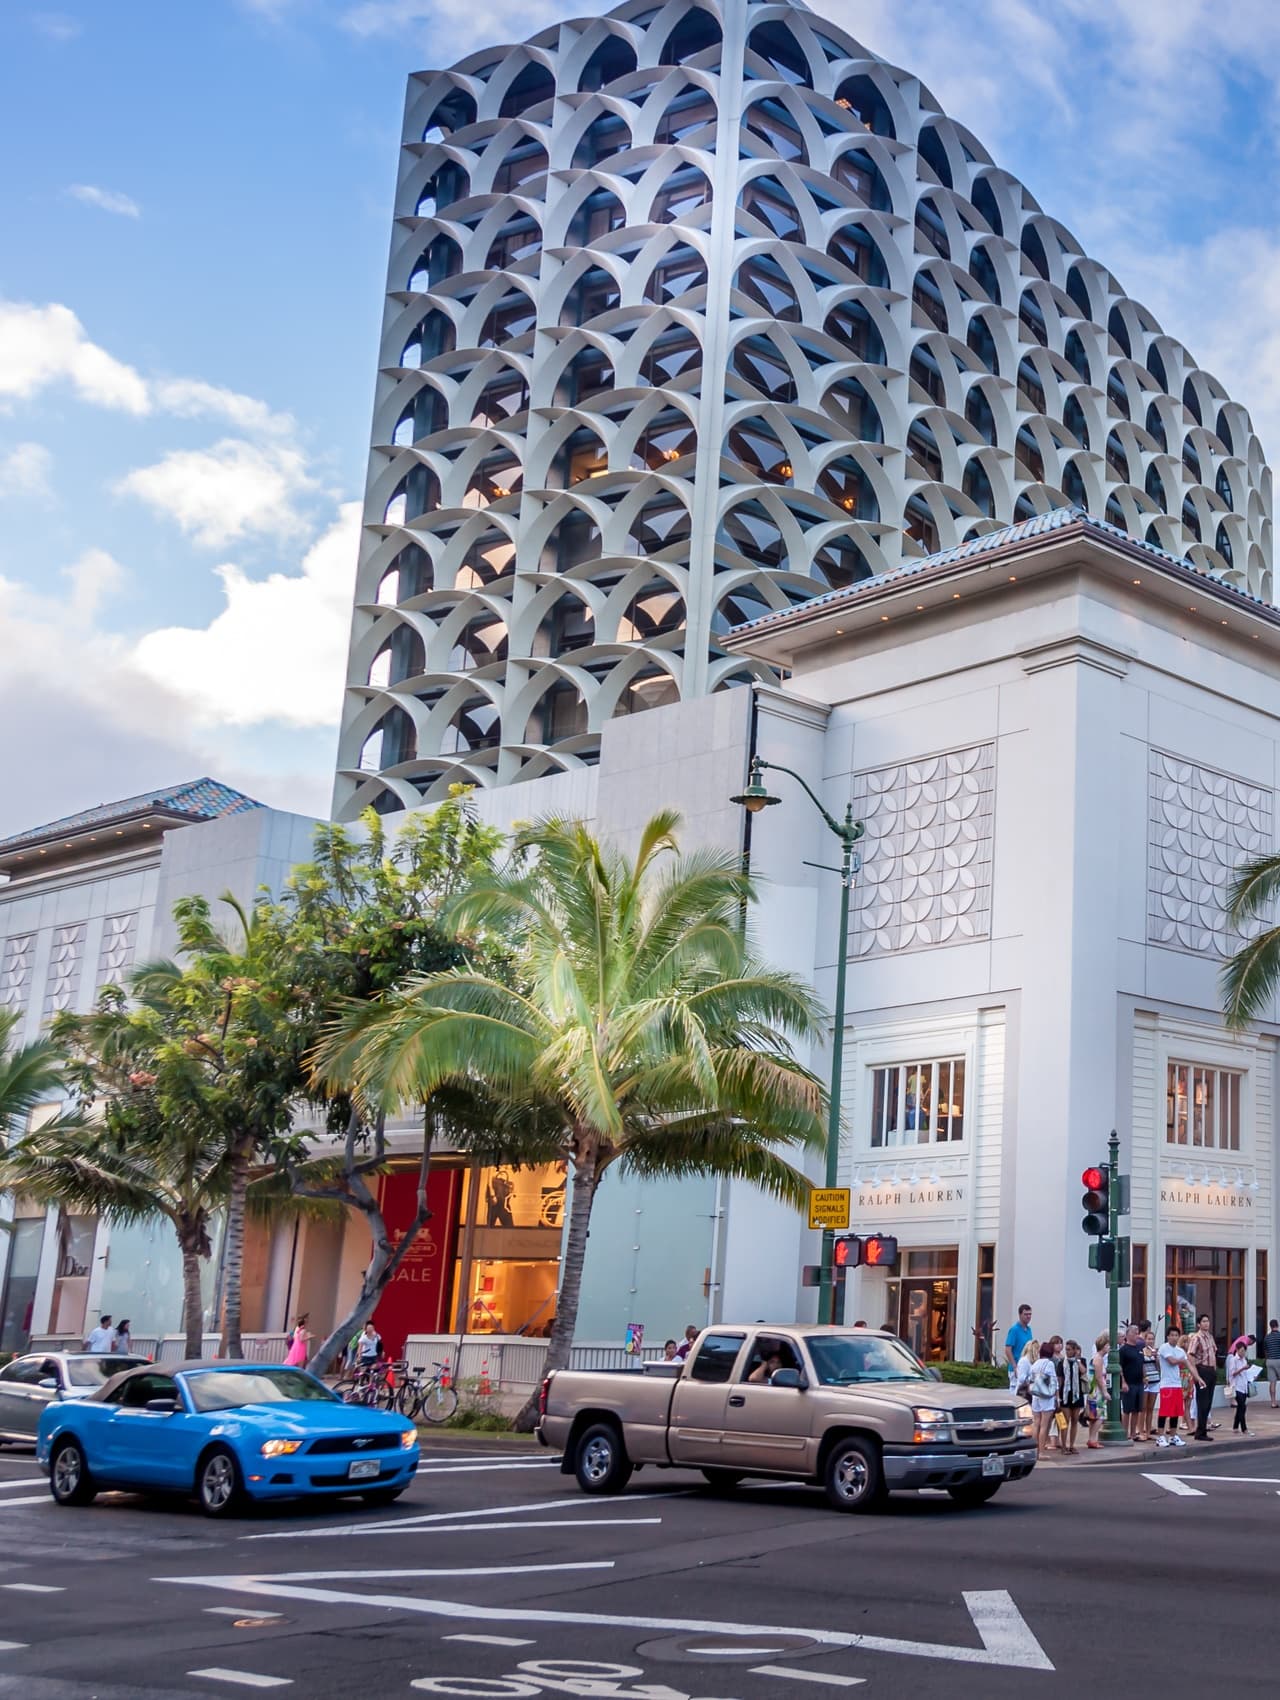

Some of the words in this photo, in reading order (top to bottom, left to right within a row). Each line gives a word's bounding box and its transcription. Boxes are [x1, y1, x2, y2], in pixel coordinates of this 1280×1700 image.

[815, 1193, 845, 1202] CAUTION
[858, 1193, 901, 1206] RALPH
[909, 1189, 963, 1203] LAUREN
[1160, 1190, 1200, 1204] RALPH
[1207, 1194, 1252, 1207] LAUREN
[815, 1204, 845, 1213] SIGNALS
[812, 1215, 846, 1224] MODIFIED
[64, 1255, 88, 1276] Dior
